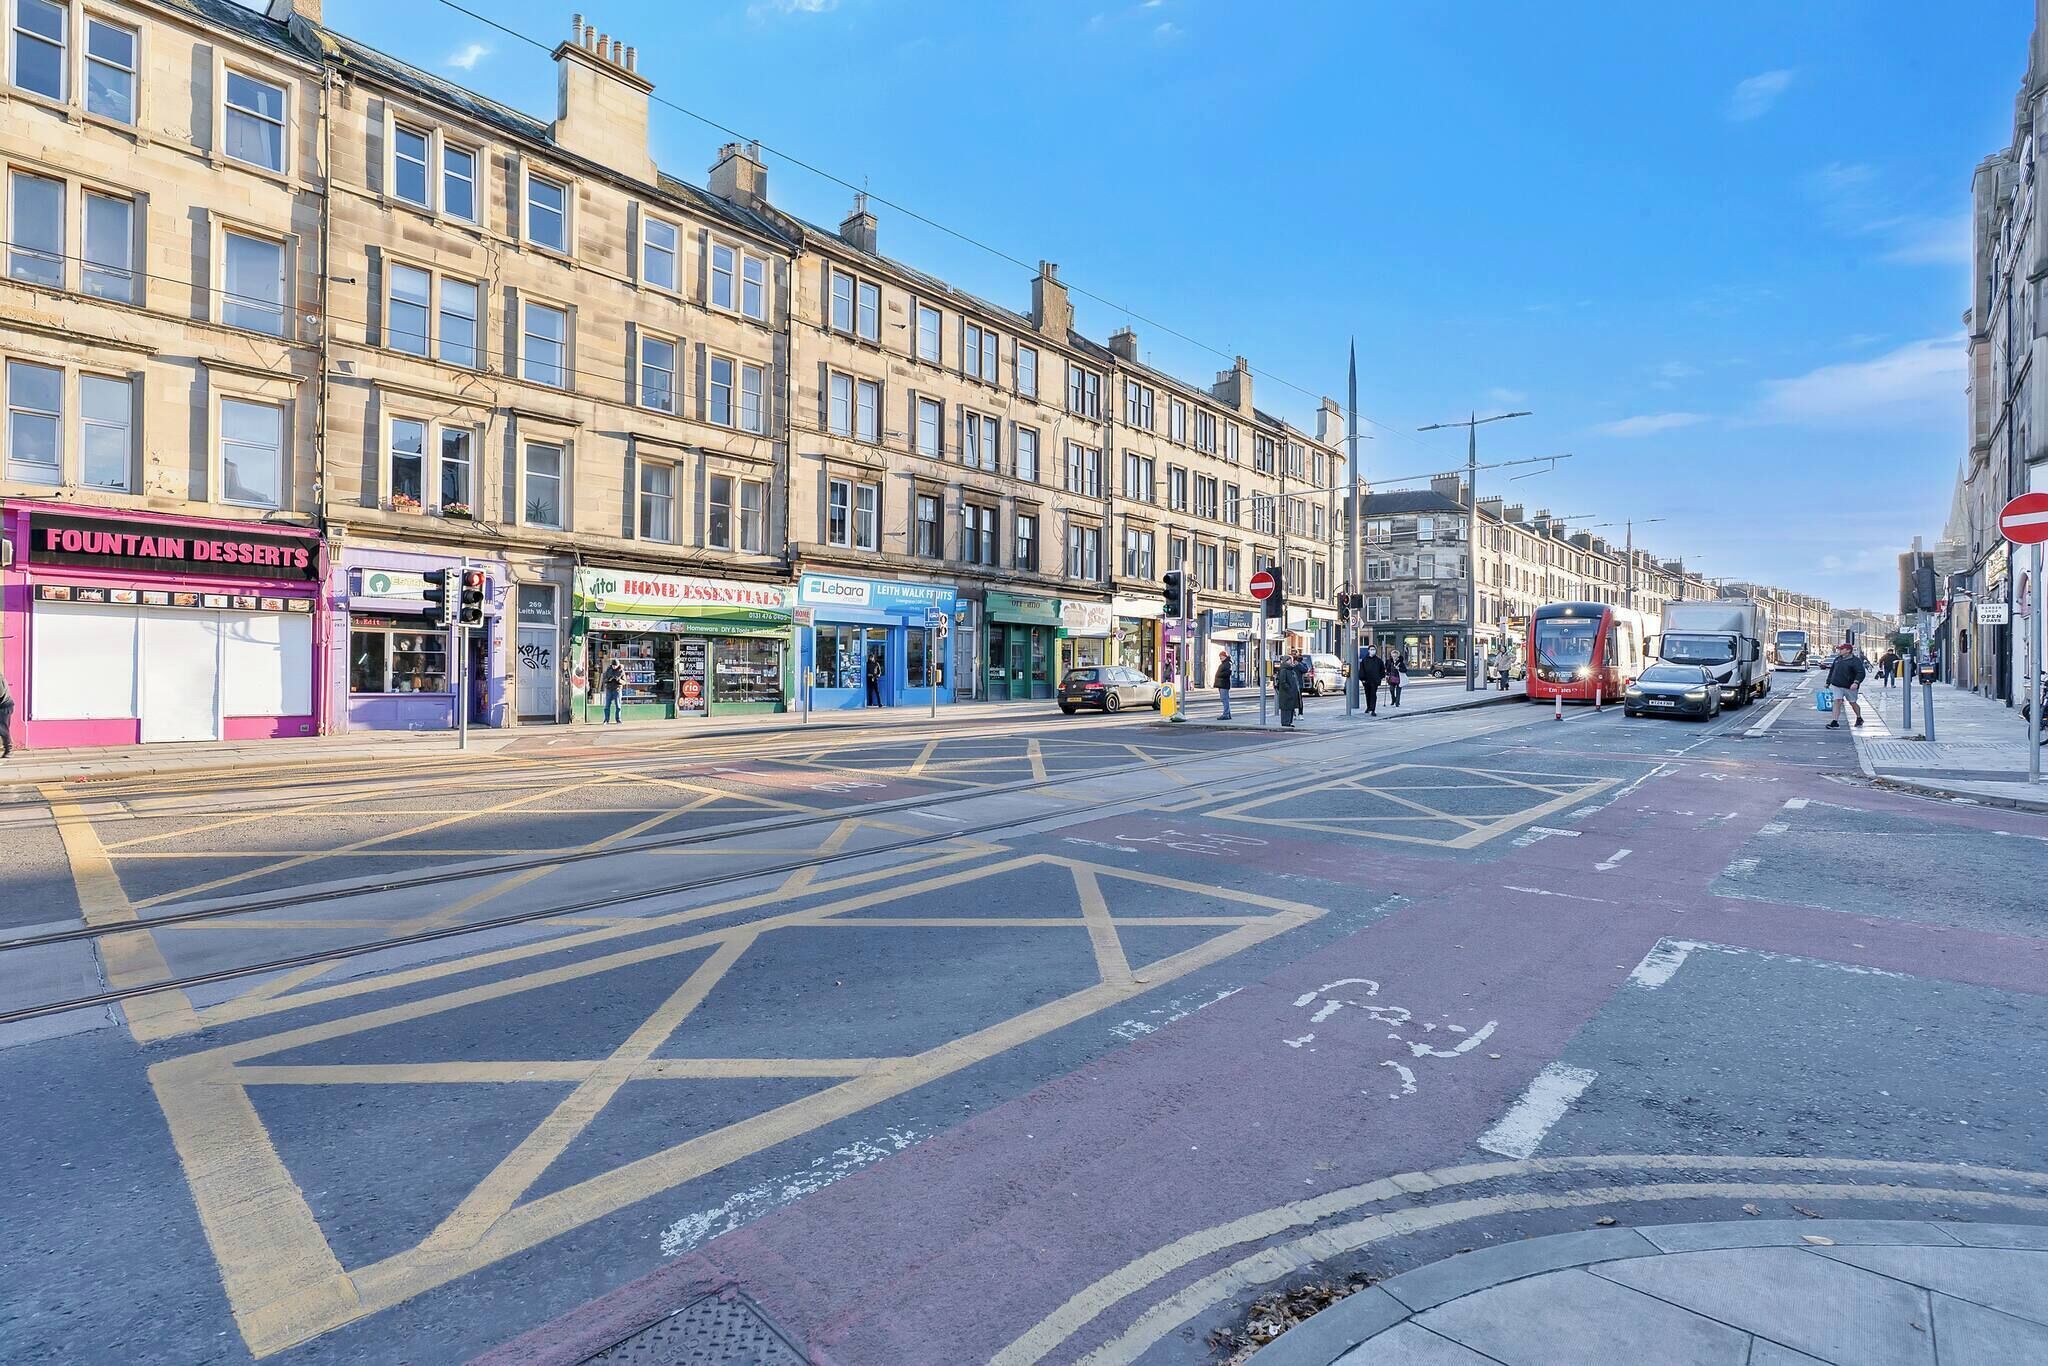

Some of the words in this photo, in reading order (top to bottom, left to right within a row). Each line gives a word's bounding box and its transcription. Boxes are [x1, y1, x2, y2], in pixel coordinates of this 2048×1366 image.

[47, 528, 185, 559] FOUNTAIN
[193, 540, 309, 568] DESSERTS
[590, 577, 617, 595] vital
[624, 579, 680, 598] HOME
[684, 584, 782, 606] ESSENTIALS
[821, 581, 864, 597] Lebara
[877, 584, 900, 596] LEITH
[902, 587, 925, 599] WALK
[518, 607, 535, 615] Leith
[536, 608, 552, 616] Walk
[687, 625, 719, 633] Homeware
[684, 682, 699, 692] ria
